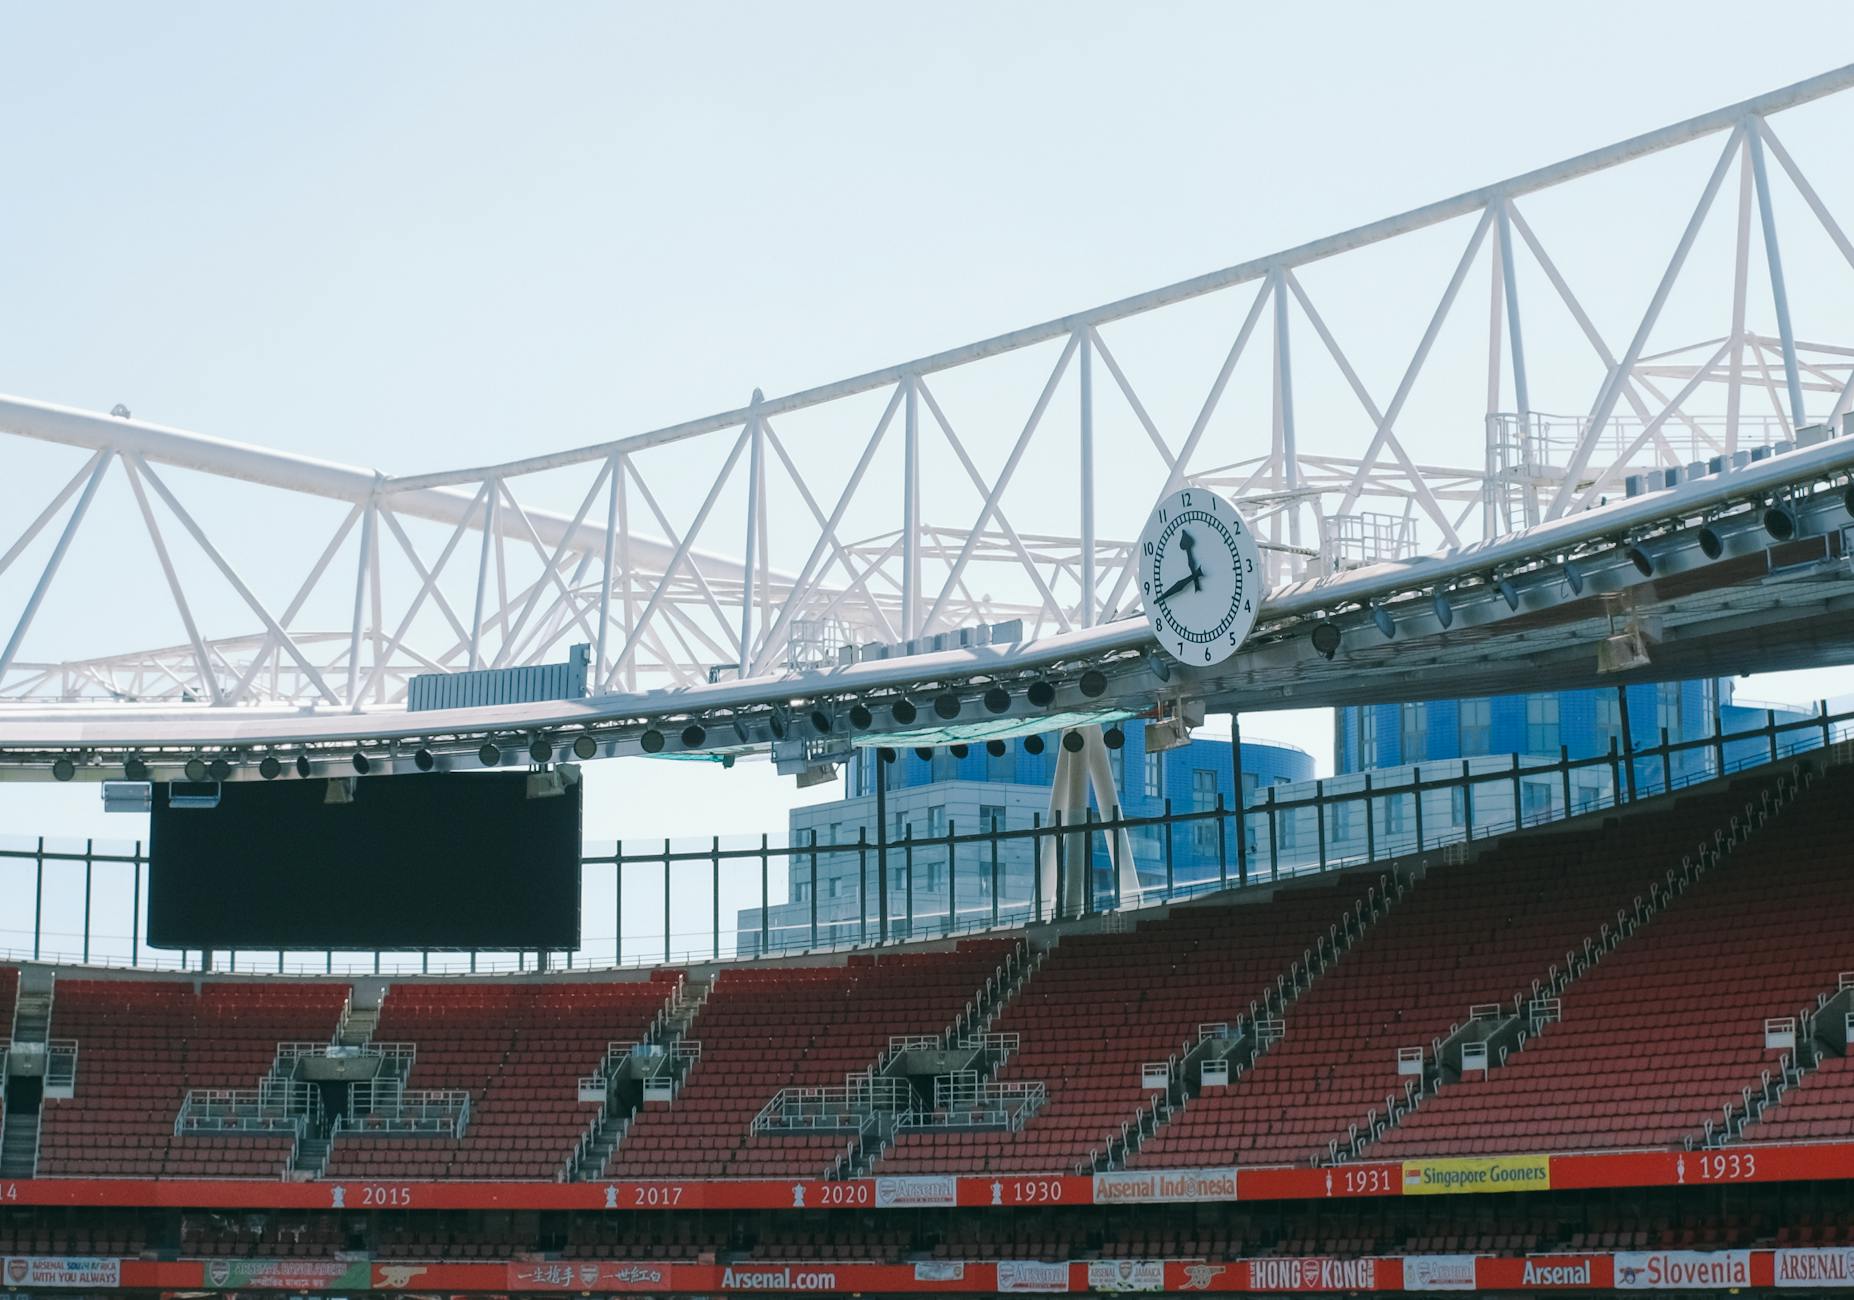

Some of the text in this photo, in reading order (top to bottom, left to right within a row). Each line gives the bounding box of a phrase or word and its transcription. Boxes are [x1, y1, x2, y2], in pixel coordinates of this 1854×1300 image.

[1181, 493, 1192, 507] 12
[1159, 509, 1167, 523] 11
[1233, 521, 1241, 535] 2
[1143, 542, 1154, 556] 10
[1246, 559, 1253, 572] 3
[1144, 582, 1150, 595] 9
[1244, 600, 1251, 613] 4
[1156, 618, 1163, 631] 8
[1230, 632, 1236, 646] 5
[1177, 642, 1184, 656] 7
[1204, 648, 1211, 661] 6
[1423, 1164, 1546, 1187] Singapore Gooners
[1700, 1154, 1756, 1179] 1933
[896, 1178, 953, 1197] Arsenal
[1097, 1176, 1155, 1199] Arsenal
[1345, 1170, 1391, 1193] 1931
[362, 1187, 411, 1205] 2015
[635, 1187, 682, 1205] 2017
[821, 1185, 868, 1204] 2020
[1014, 1181, 1062, 1201] 1930
[1015, 1263, 1067, 1282] Arsenal
[1257, 1260, 1301, 1289] HONG
[1322, 1259, 1367, 1288] KONG
[1522, 1260, 1591, 1285] Arsenal
[1647, 1253, 1746, 1285] Slovenia
[1780, 1253, 1847, 1280] ARSENAL
[32, 1272, 117, 1283] WITH YOU ALWAYS
[721, 1267, 836, 1290] Arsenal.com
